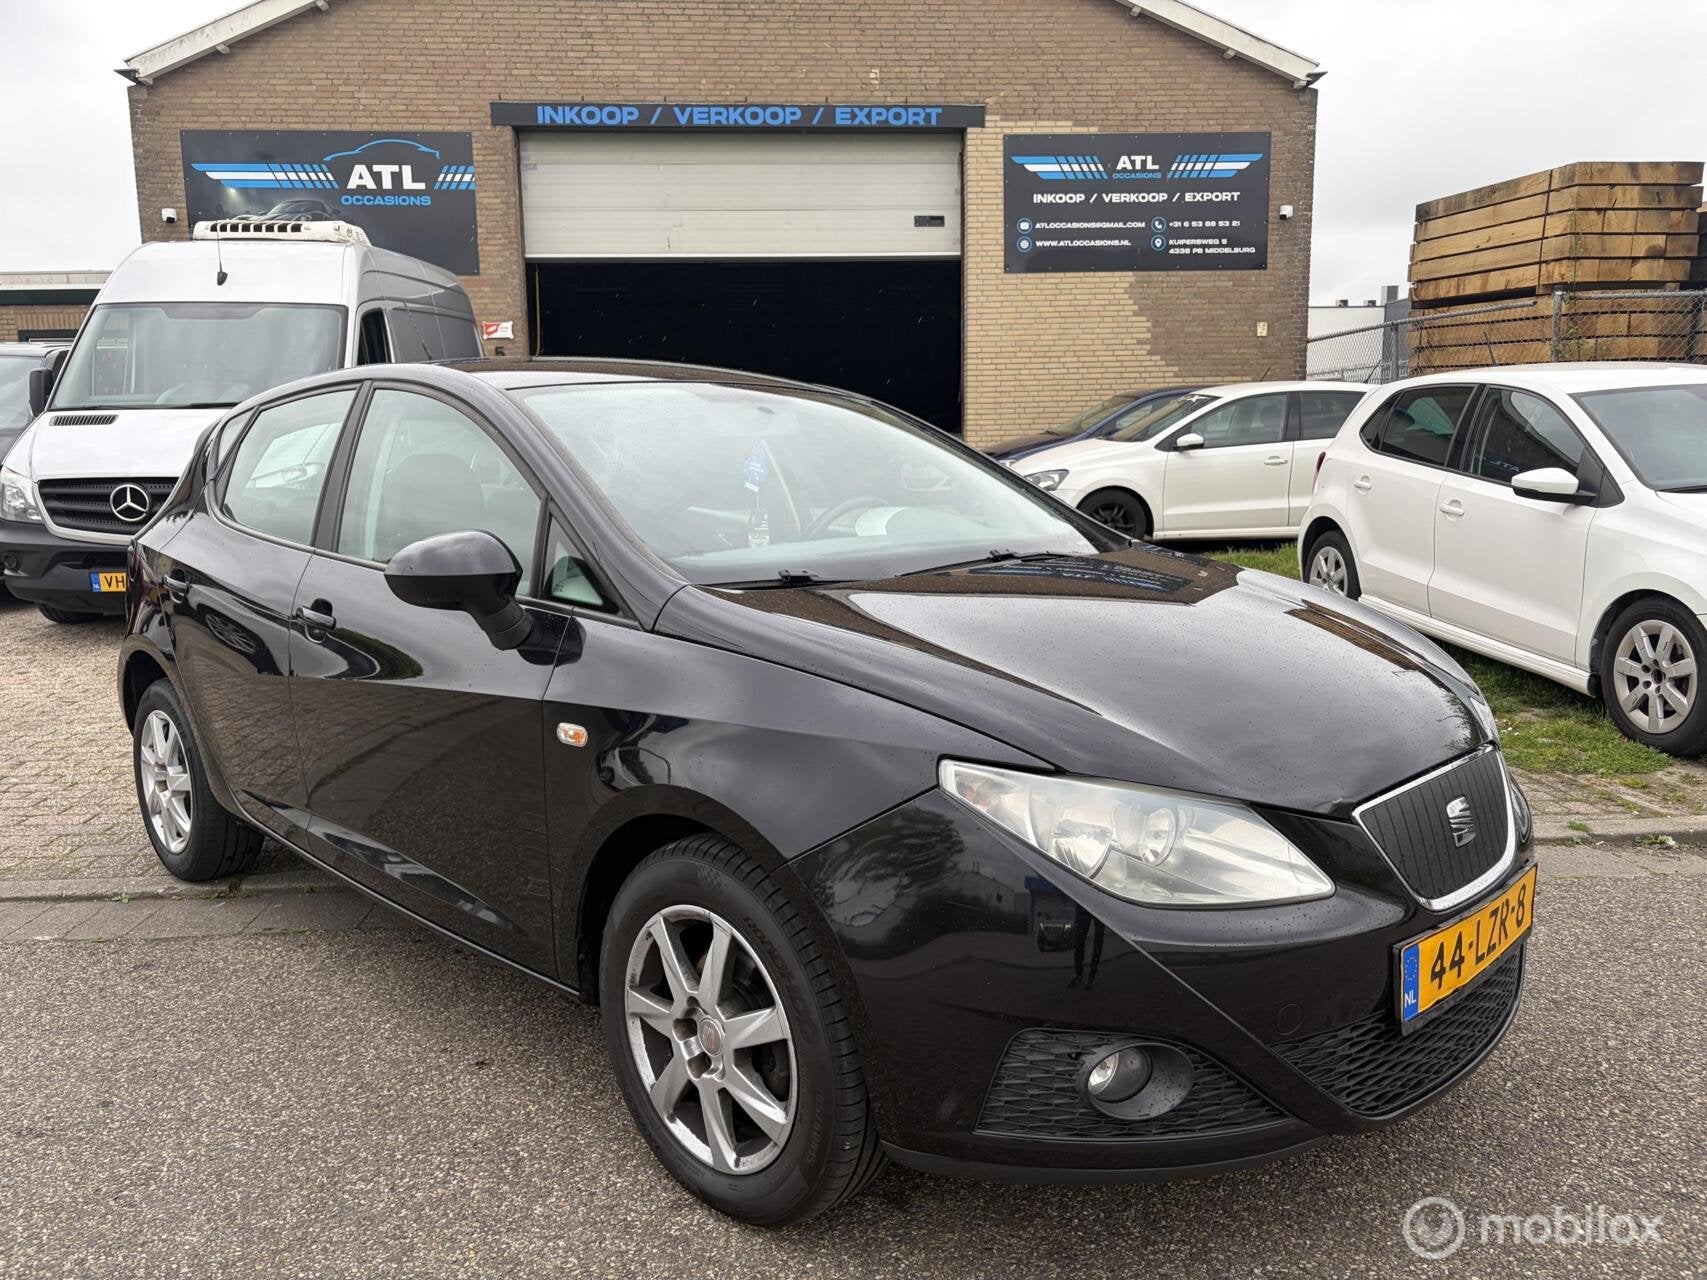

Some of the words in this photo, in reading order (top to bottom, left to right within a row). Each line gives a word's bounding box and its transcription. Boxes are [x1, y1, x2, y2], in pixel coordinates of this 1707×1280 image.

[536, 105, 640, 125] INKOOP
[650, 107, 662, 124] /
[672, 105, 803, 126] VERKOOP
[812, 107, 825, 124] /
[835, 106, 943, 126] EXPORT
[1115, 155, 1160, 170] ATL
[346, 164, 426, 190] ATL
[1112, 172, 1162, 180] OCCASIONS
[340, 195, 432, 207] OCCASIONS
[1033, 193, 1086, 204] INKOOP
[1101, 192, 1168, 203] VERKOOP
[1184, 191, 1241, 202] EXPORT
[1035, 239, 1132, 247] WWW.ATLOCCASIONS.NL
[1204, 246, 1256, 254] MIDDELBURG
[104, 576, 125, 588] VH
[1430, 883, 1527, 990] 44-LZR-8
[1404, 989, 1417, 1009] NL
